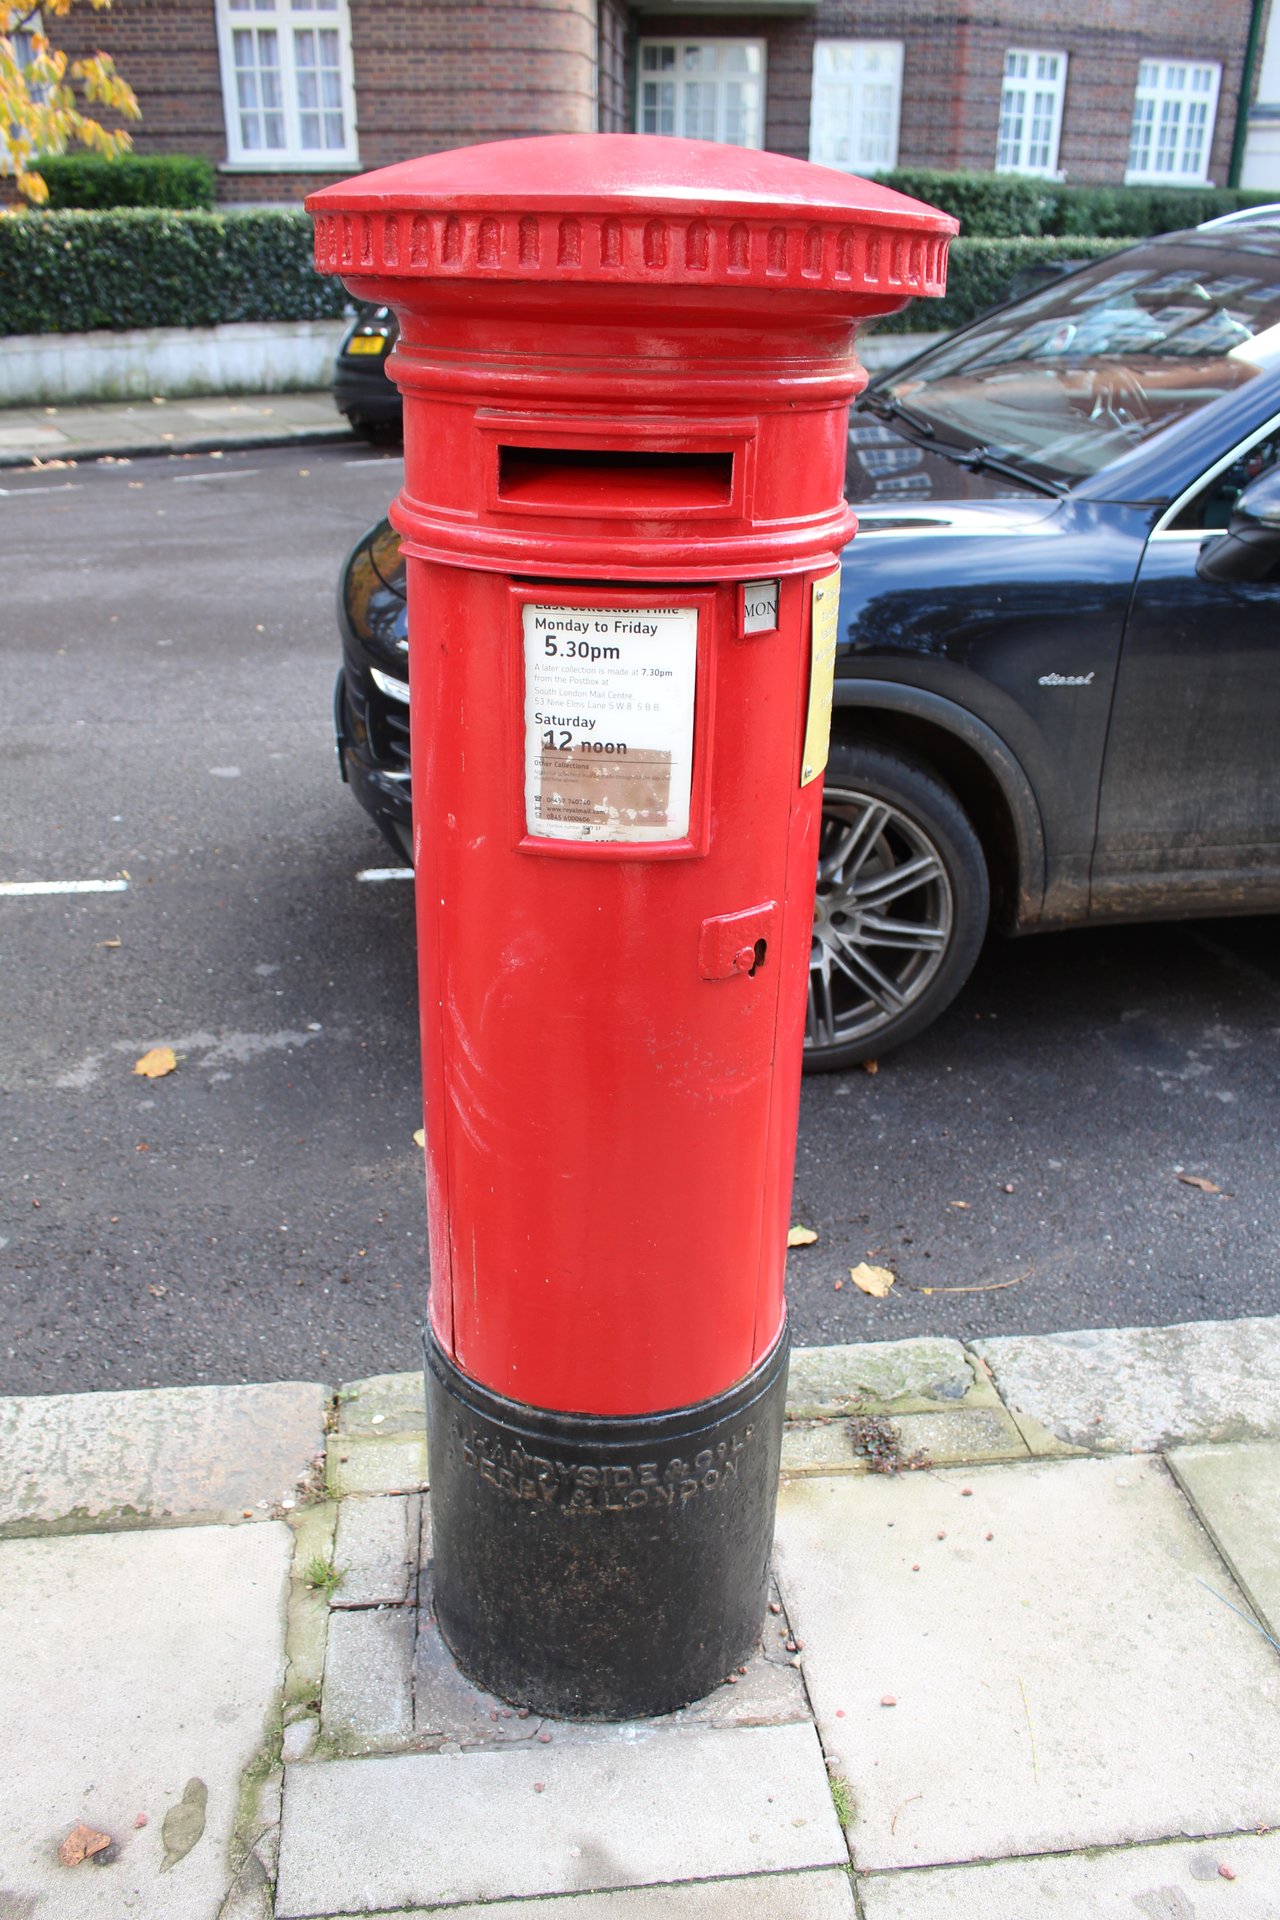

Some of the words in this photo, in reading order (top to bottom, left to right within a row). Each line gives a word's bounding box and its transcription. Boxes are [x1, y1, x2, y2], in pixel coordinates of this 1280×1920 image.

[744, 600, 777, 618] MON
[535, 617, 590, 635] Monday
[594, 621, 609, 633] to
[614, 620, 659, 637] Friday
[544, 635, 620, 662] 5.30pm
[534, 663, 540, 671] A
[541, 664, 559, 672] later
[561, 665, 596, 674] collection
[598, 667, 605, 675] is
[607, 668, 629, 676] made
[641, 668, 673, 678] 7.30pm
[534, 673, 553, 682] from
[554, 675, 567, 684] the
[569, 675, 599, 685] Postbox
[534, 686, 557, 696] South
[559, 689, 587, 698] London
[589, 690, 605, 699] Mail
[534, 697, 545, 706] 53
[547, 698, 565, 707] Nine
[566, 699, 585, 708] Elms
[587, 701, 606, 709] Lane
[535, 712, 597, 730] Saturday
[543, 729, 573, 751] 12
[580, 740, 628, 755] noon
[534, 759, 553, 768] Other
[554, 761, 590, 770] Collections
[604, 1455, 740, 1512] LONDON
